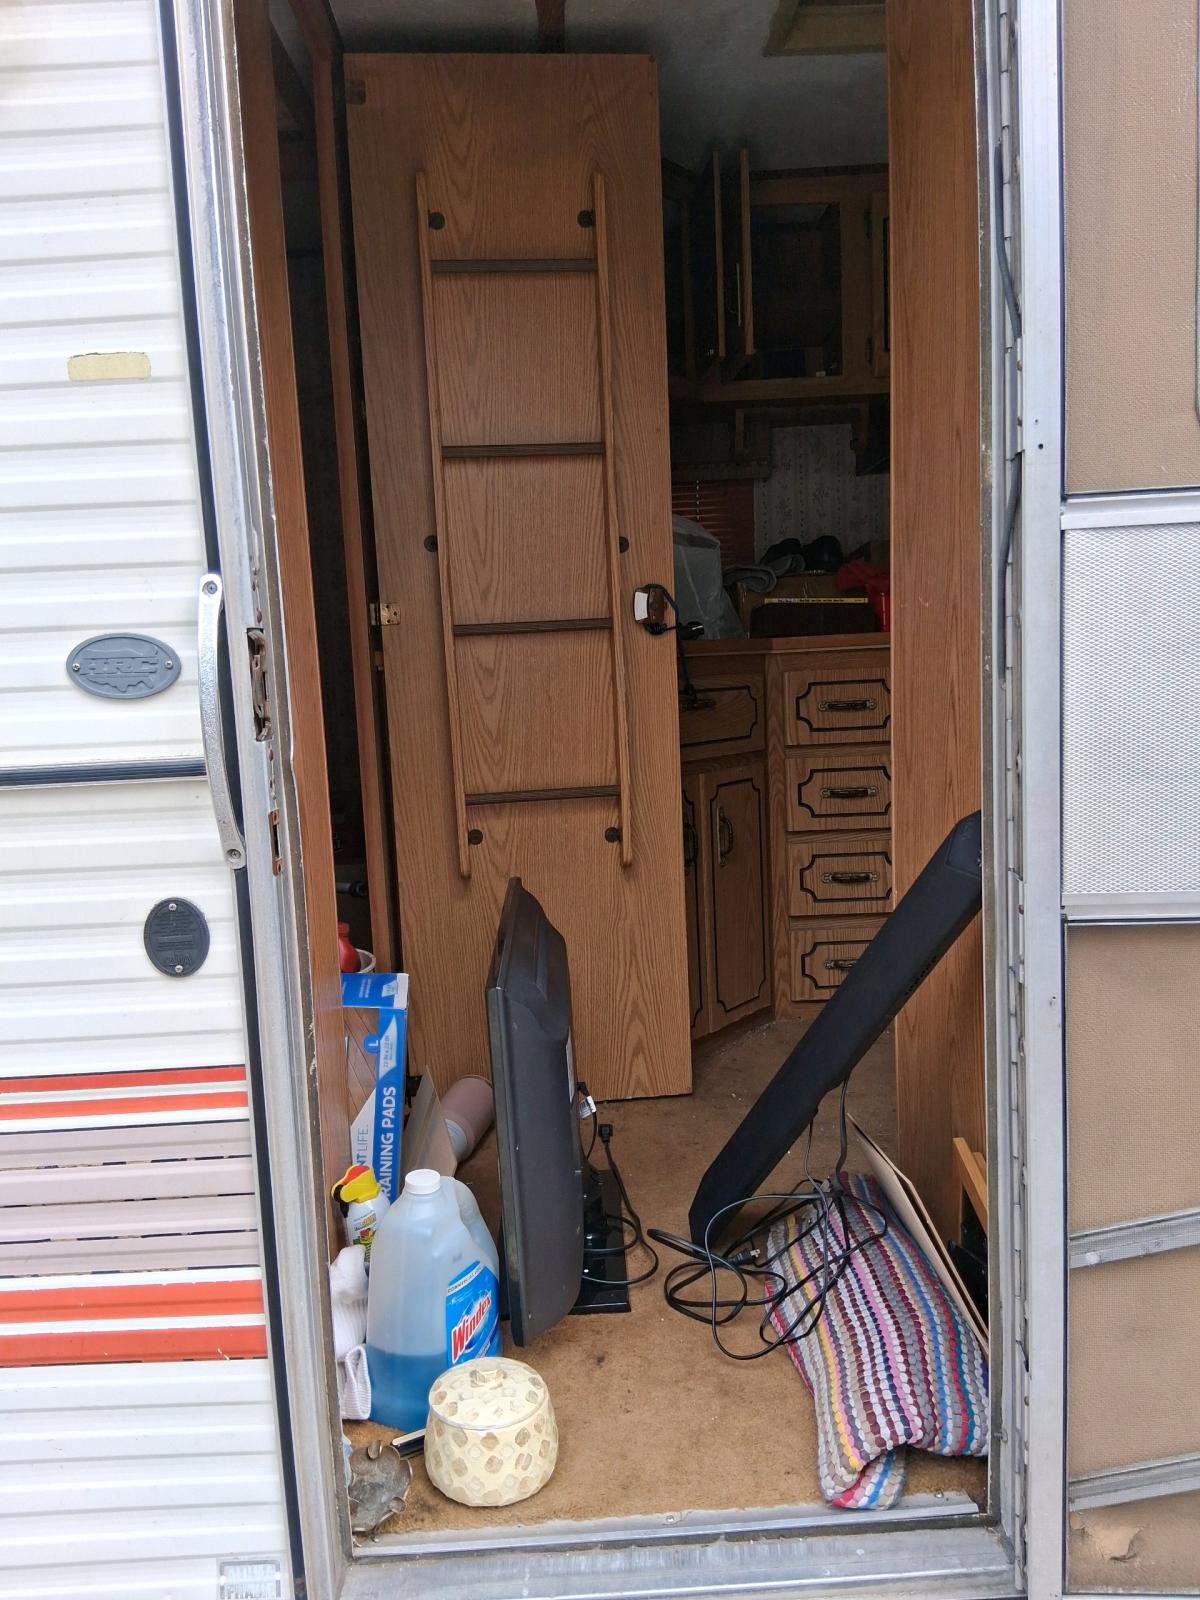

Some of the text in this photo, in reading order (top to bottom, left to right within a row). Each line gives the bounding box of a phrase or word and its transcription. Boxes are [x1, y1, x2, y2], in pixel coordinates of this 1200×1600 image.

[380, 1086, 396, 1196] RAINING PADS
[452, 1295, 491, 1363] Windex
